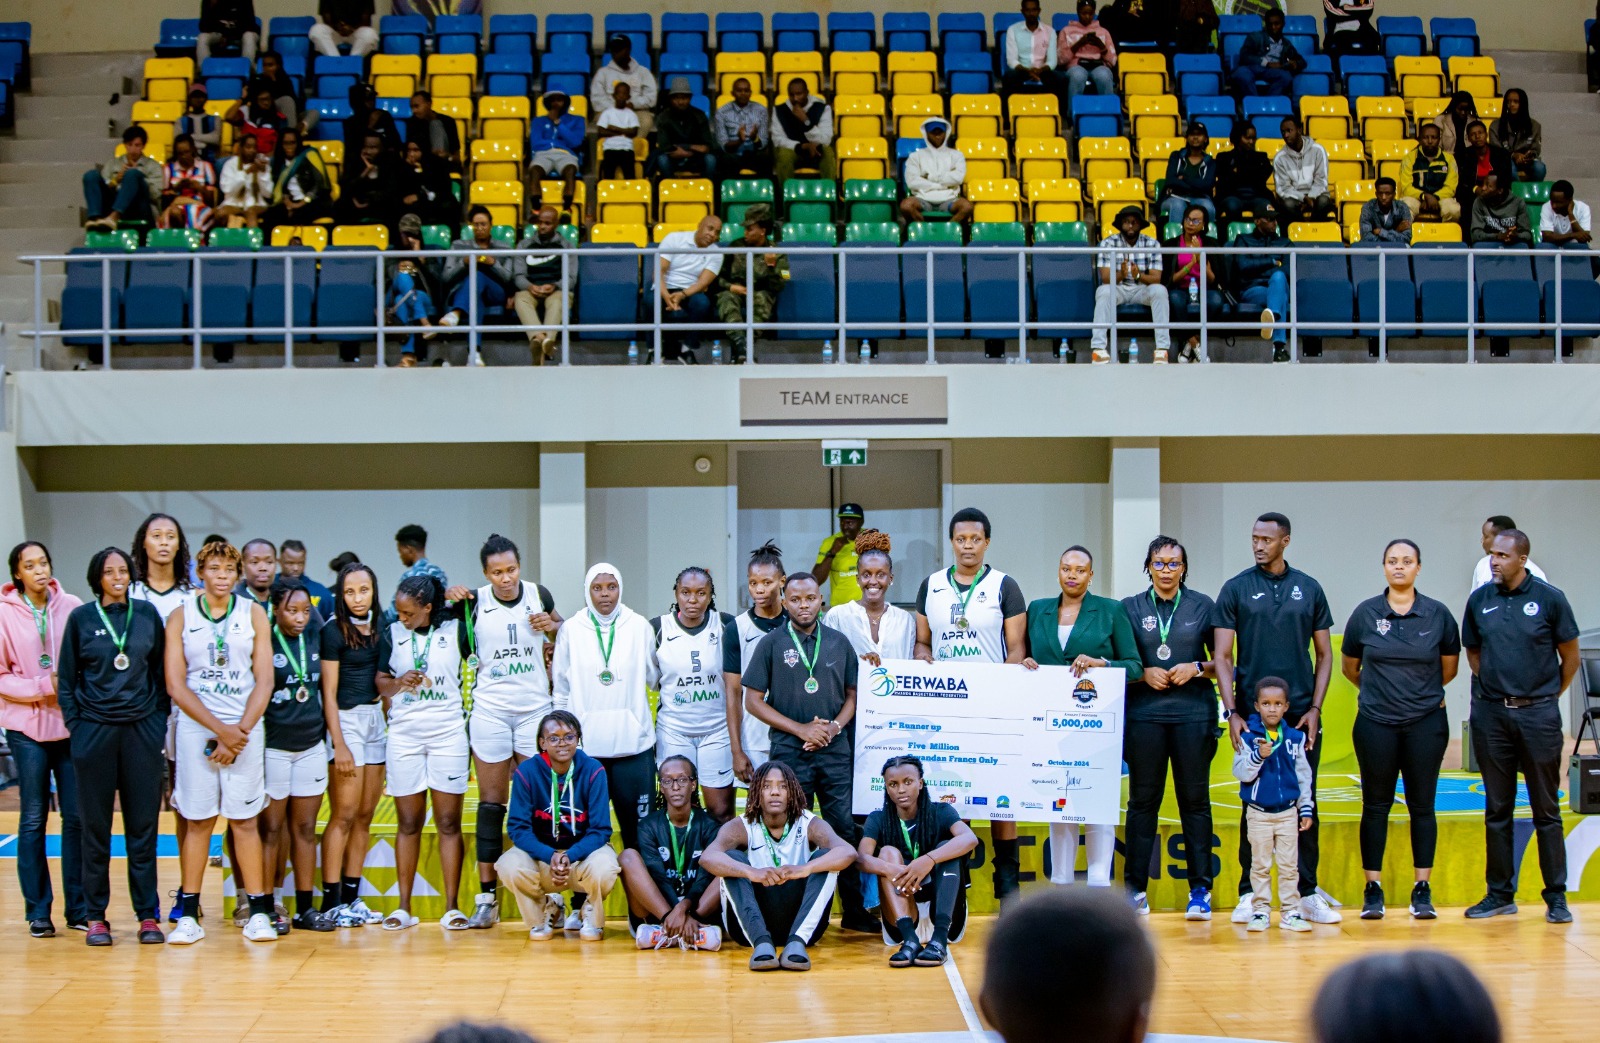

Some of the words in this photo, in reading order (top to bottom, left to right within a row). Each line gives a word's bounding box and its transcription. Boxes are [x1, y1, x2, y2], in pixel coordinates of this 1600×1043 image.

[779, 391, 830, 405] TEAM
[835, 393, 909, 405] ENTRANCE
[507, 623, 518, 645] 11
[967, 631, 977, 639] W
[523, 647, 534, 657] W
[691, 651, 702, 673] 5
[229, 670, 241, 681] W
[434, 676, 445, 686] W
[707, 675, 717, 684] W
[895, 675, 969, 692] FERWABA
[899, 722, 929, 730] Runner
[931, 724, 942, 732] up
[1052, 718, 1103, 729] 5,000,000
[907, 742, 926, 750] Five
[930, 742, 960, 751] Million
[949, 755, 977, 764] Francs
[979, 756, 999, 766] Only
